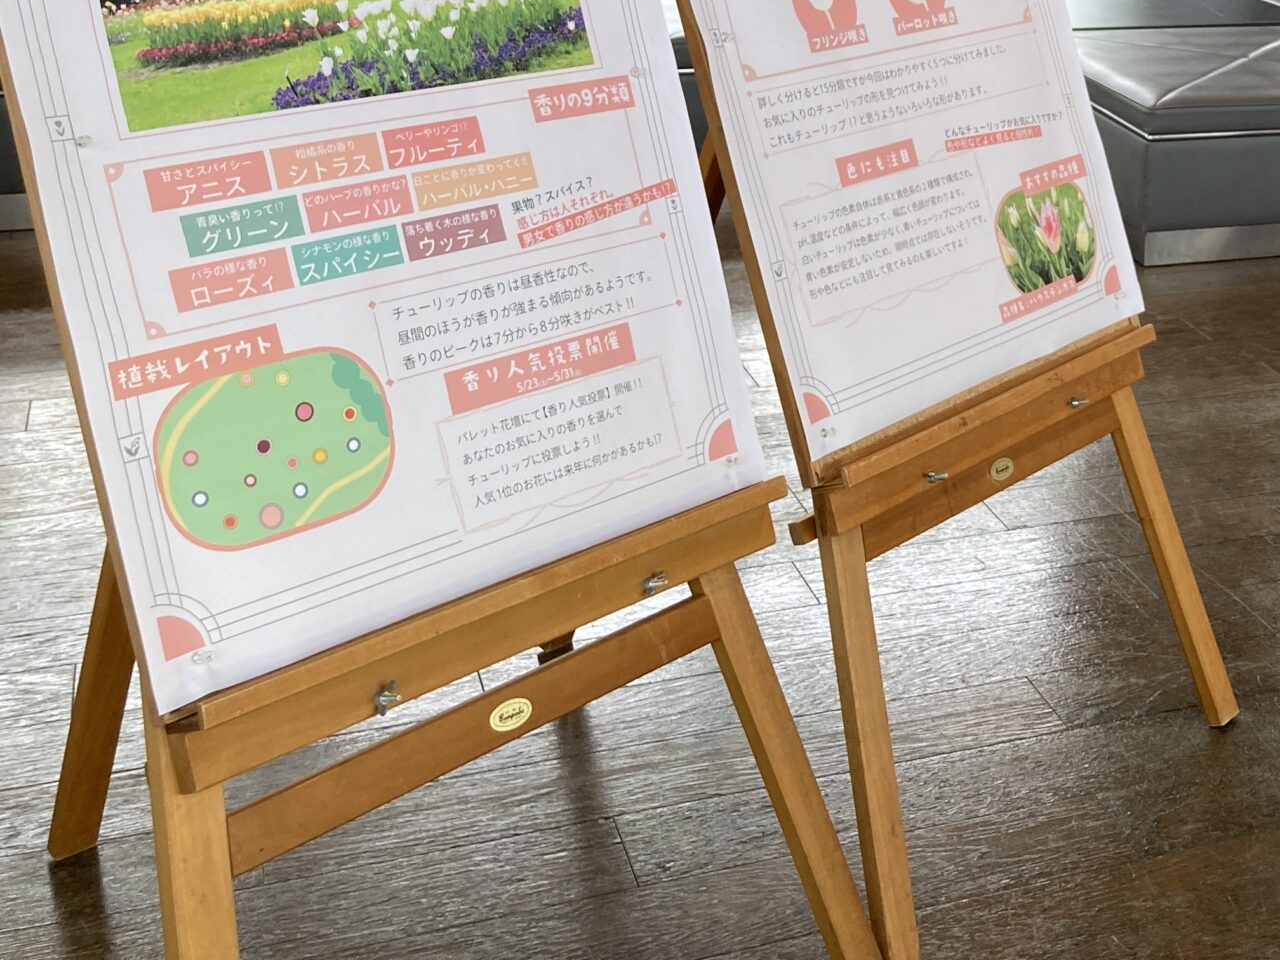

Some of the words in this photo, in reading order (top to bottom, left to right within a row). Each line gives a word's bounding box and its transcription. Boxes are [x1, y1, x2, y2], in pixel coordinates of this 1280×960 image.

[813, 29, 866, 49] フリンジ咲き
[534, 82, 632, 115] 香りの9分類
[295, 140, 356, 159] 柑橘系の香り
[389, 138, 479, 167] フルーティ
[847, 148, 911, 179] 色にも注目
[160, 159, 253, 183] 甘さとスパイシー
[289, 154, 371, 185] シトラス
[177, 176, 246, 205] アニス
[422, 175, 534, 206] ハーバル・ハニー
[321, 196, 401, 226] ハーバル
[202, 219, 289, 253] グリーン
[300, 231, 390, 257] シナモンの様な香り
[419, 228, 490, 257] ウッディ
[191, 256, 267, 281] バラの様な香り
[301, 248, 400, 284] スパイシー
[117, 336, 272, 389] 植栽レイアウト
[462, 330, 620, 392] 香り人気投票開催
[462, 404, 623, 465] あなたのお気に入りの香りを選んで
